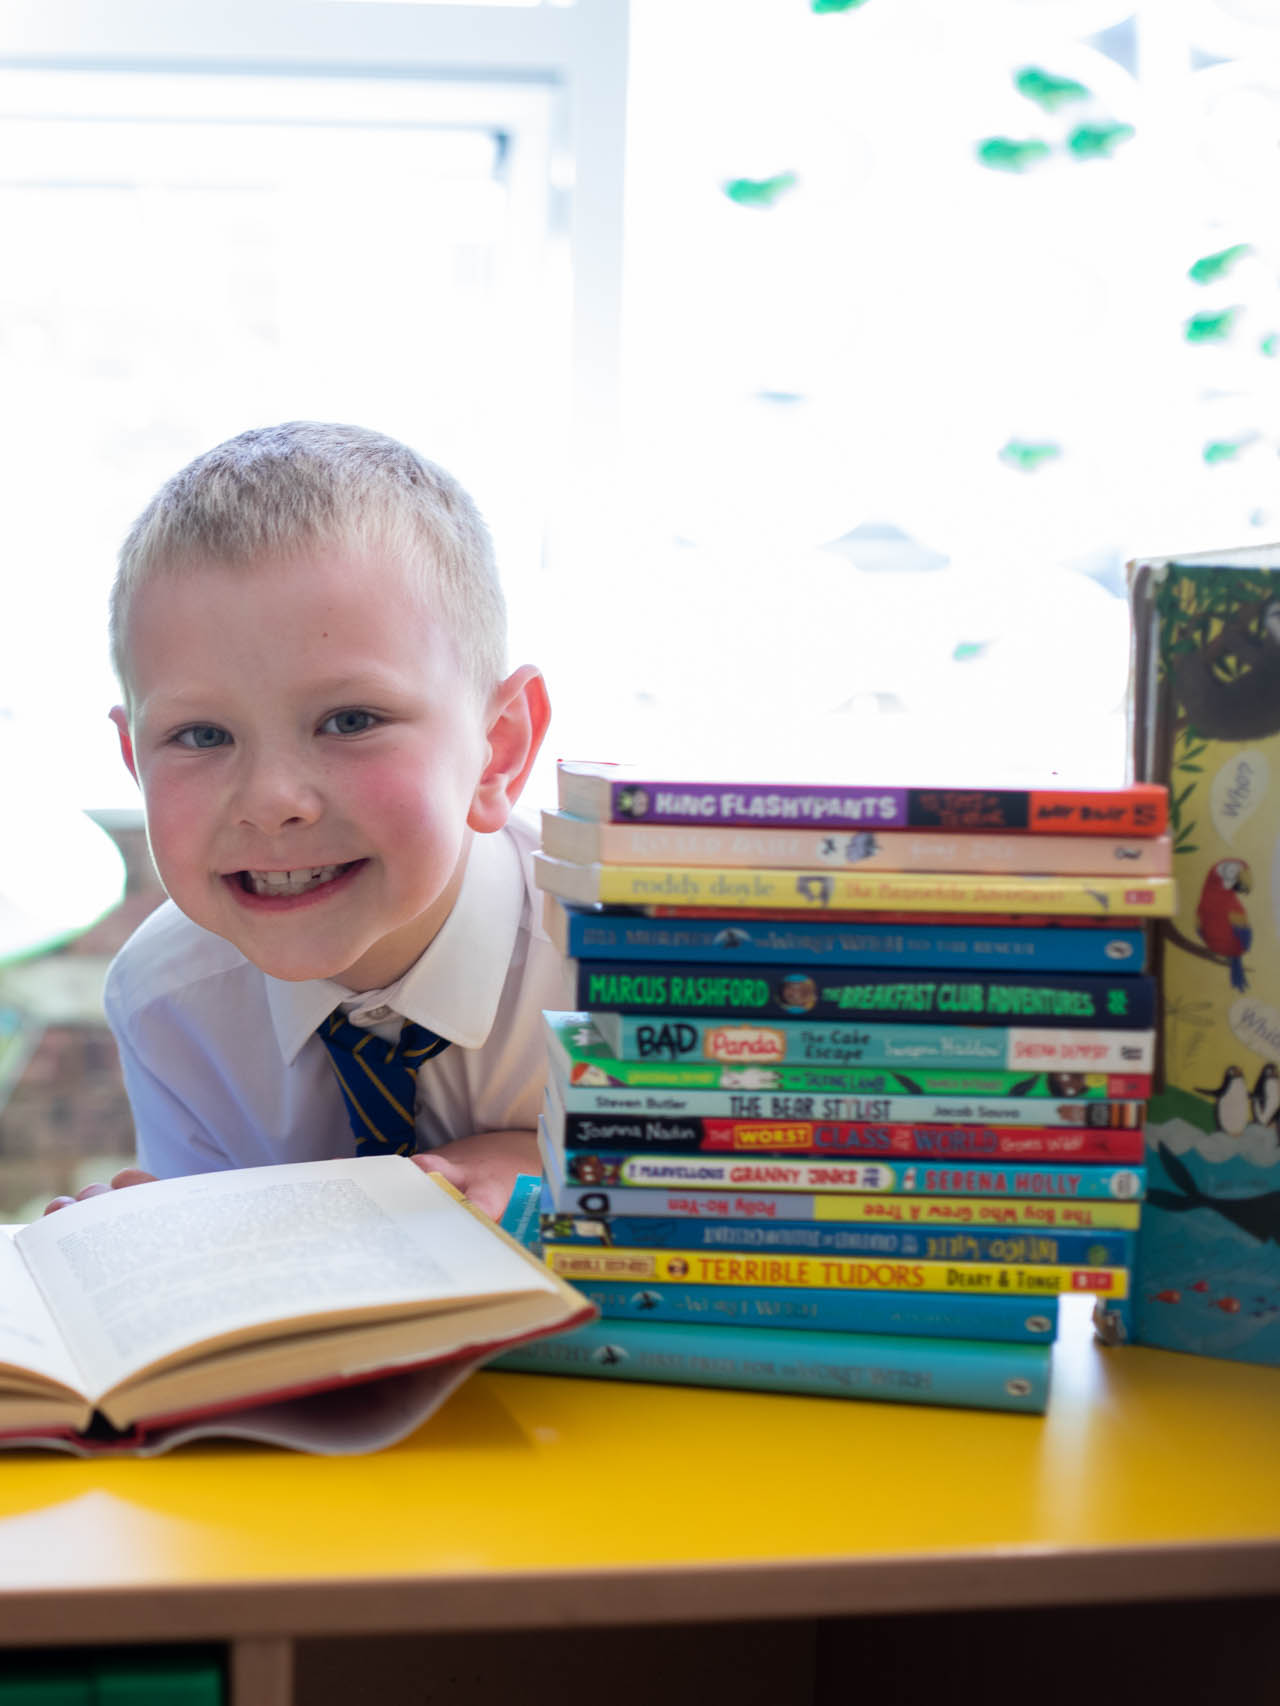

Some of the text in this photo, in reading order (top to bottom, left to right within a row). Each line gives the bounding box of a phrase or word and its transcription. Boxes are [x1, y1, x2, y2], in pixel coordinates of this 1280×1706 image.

[655, 792, 897, 820] KING FLASHYPANTS
[589, 974, 769, 1007] MARCUS RASHFORD
[838, 983, 936, 1011] BREAKFAST
[936, 984, 984, 1013] CLUB
[986, 985, 1096, 1017] ADVENTURES
[636, 1023, 871, 1061] BAD Panda The Cake
[804, 1045, 864, 1063] Escape
[595, 1095, 688, 1111] Steven Butler
[729, 1095, 762, 1118] THE
[771, 1096, 815, 1119] BEAR
[933, 1104, 974, 1119] Jacob
[576, 1120, 696, 1142] Joanna Nadin
[738, 1128, 810, 1145] WORST
[815, 1126, 892, 1149] CLASS
[912, 1130, 1000, 1153] WORLD
[639, 1164, 725, 1180] MARVELLOUS
[730, 1166, 801, 1184] GRANNY
[808, 1167, 859, 1186] JINKS
[925, 1169, 1082, 1195] SERENA HOLLY
[666, 1197, 777, 1217] Polly Ho-Yen
[862, 1203, 1094, 1226] The Boy Who Grew A Tree
[697, 1257, 926, 1288] TERRIBLE TUDORS
[946, 1268, 993, 1288] DEARY
[998, 1270, 1012, 1288] &
